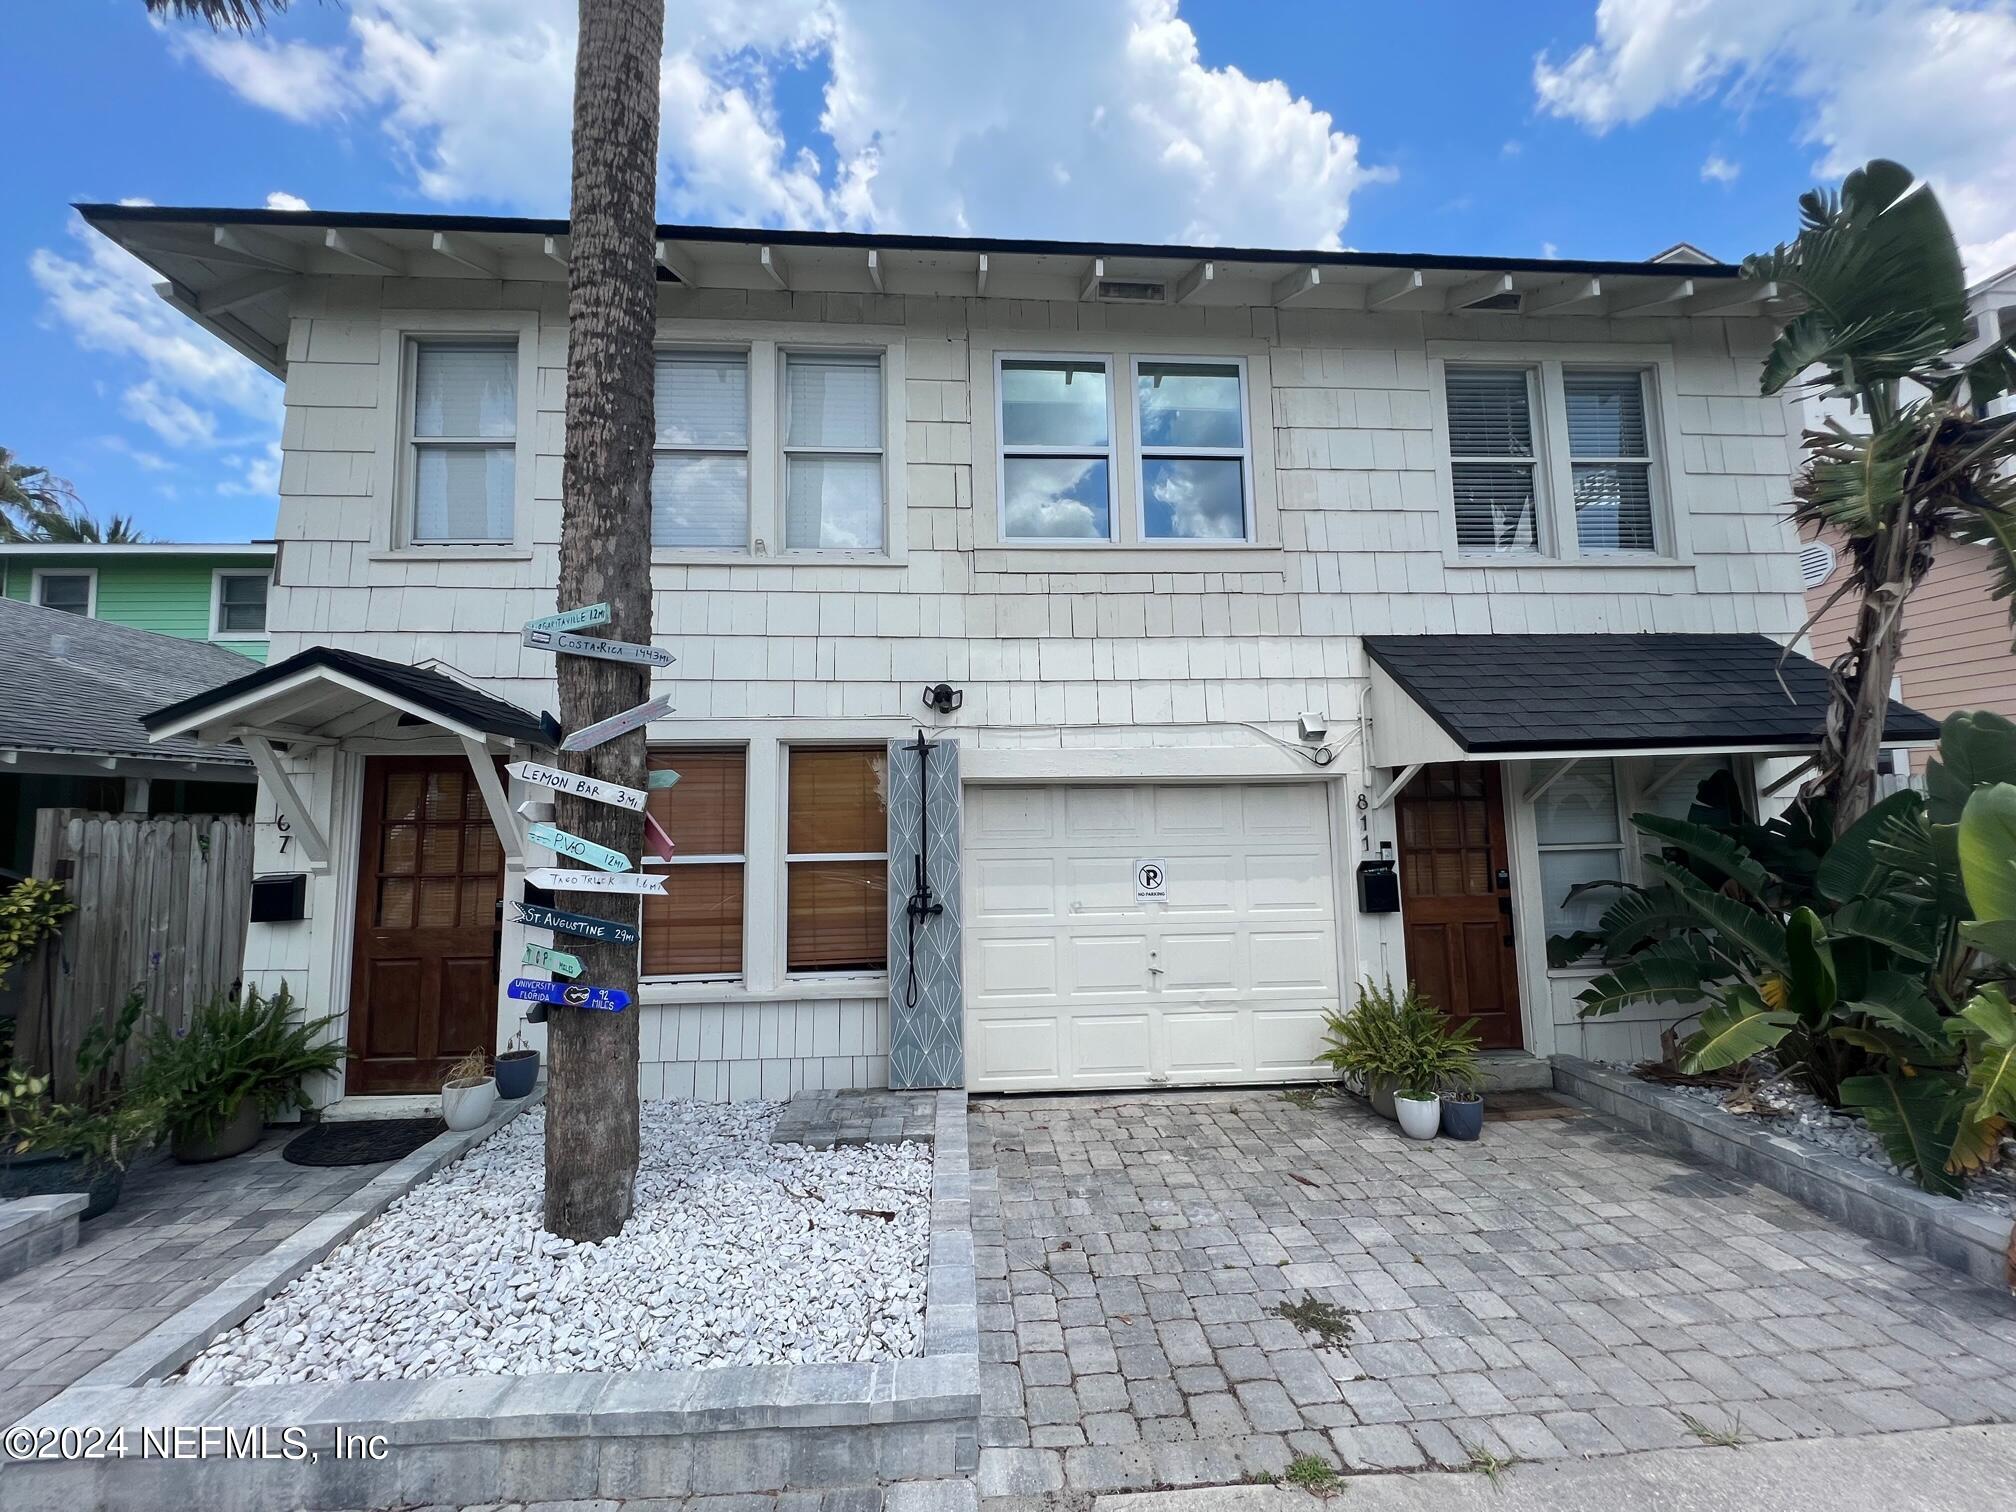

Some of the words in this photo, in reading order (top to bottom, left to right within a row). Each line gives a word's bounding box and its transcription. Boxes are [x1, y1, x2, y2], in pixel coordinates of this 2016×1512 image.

[558, 635, 596, 651] COSTA
[600, 641, 623, 656] RICA
[522, 764, 569, 789] LEMON
[576, 781, 600, 797] BAR
[549, 873, 577, 885] TACO
[544, 913, 605, 937] AUGUSTINE
[515, 979, 556, 992] UNIVERSITY
[519, 990, 550, 1002] FLORIDA
[599, 989, 609, 1001] 92
[591, 999, 615, 1011] MILES
